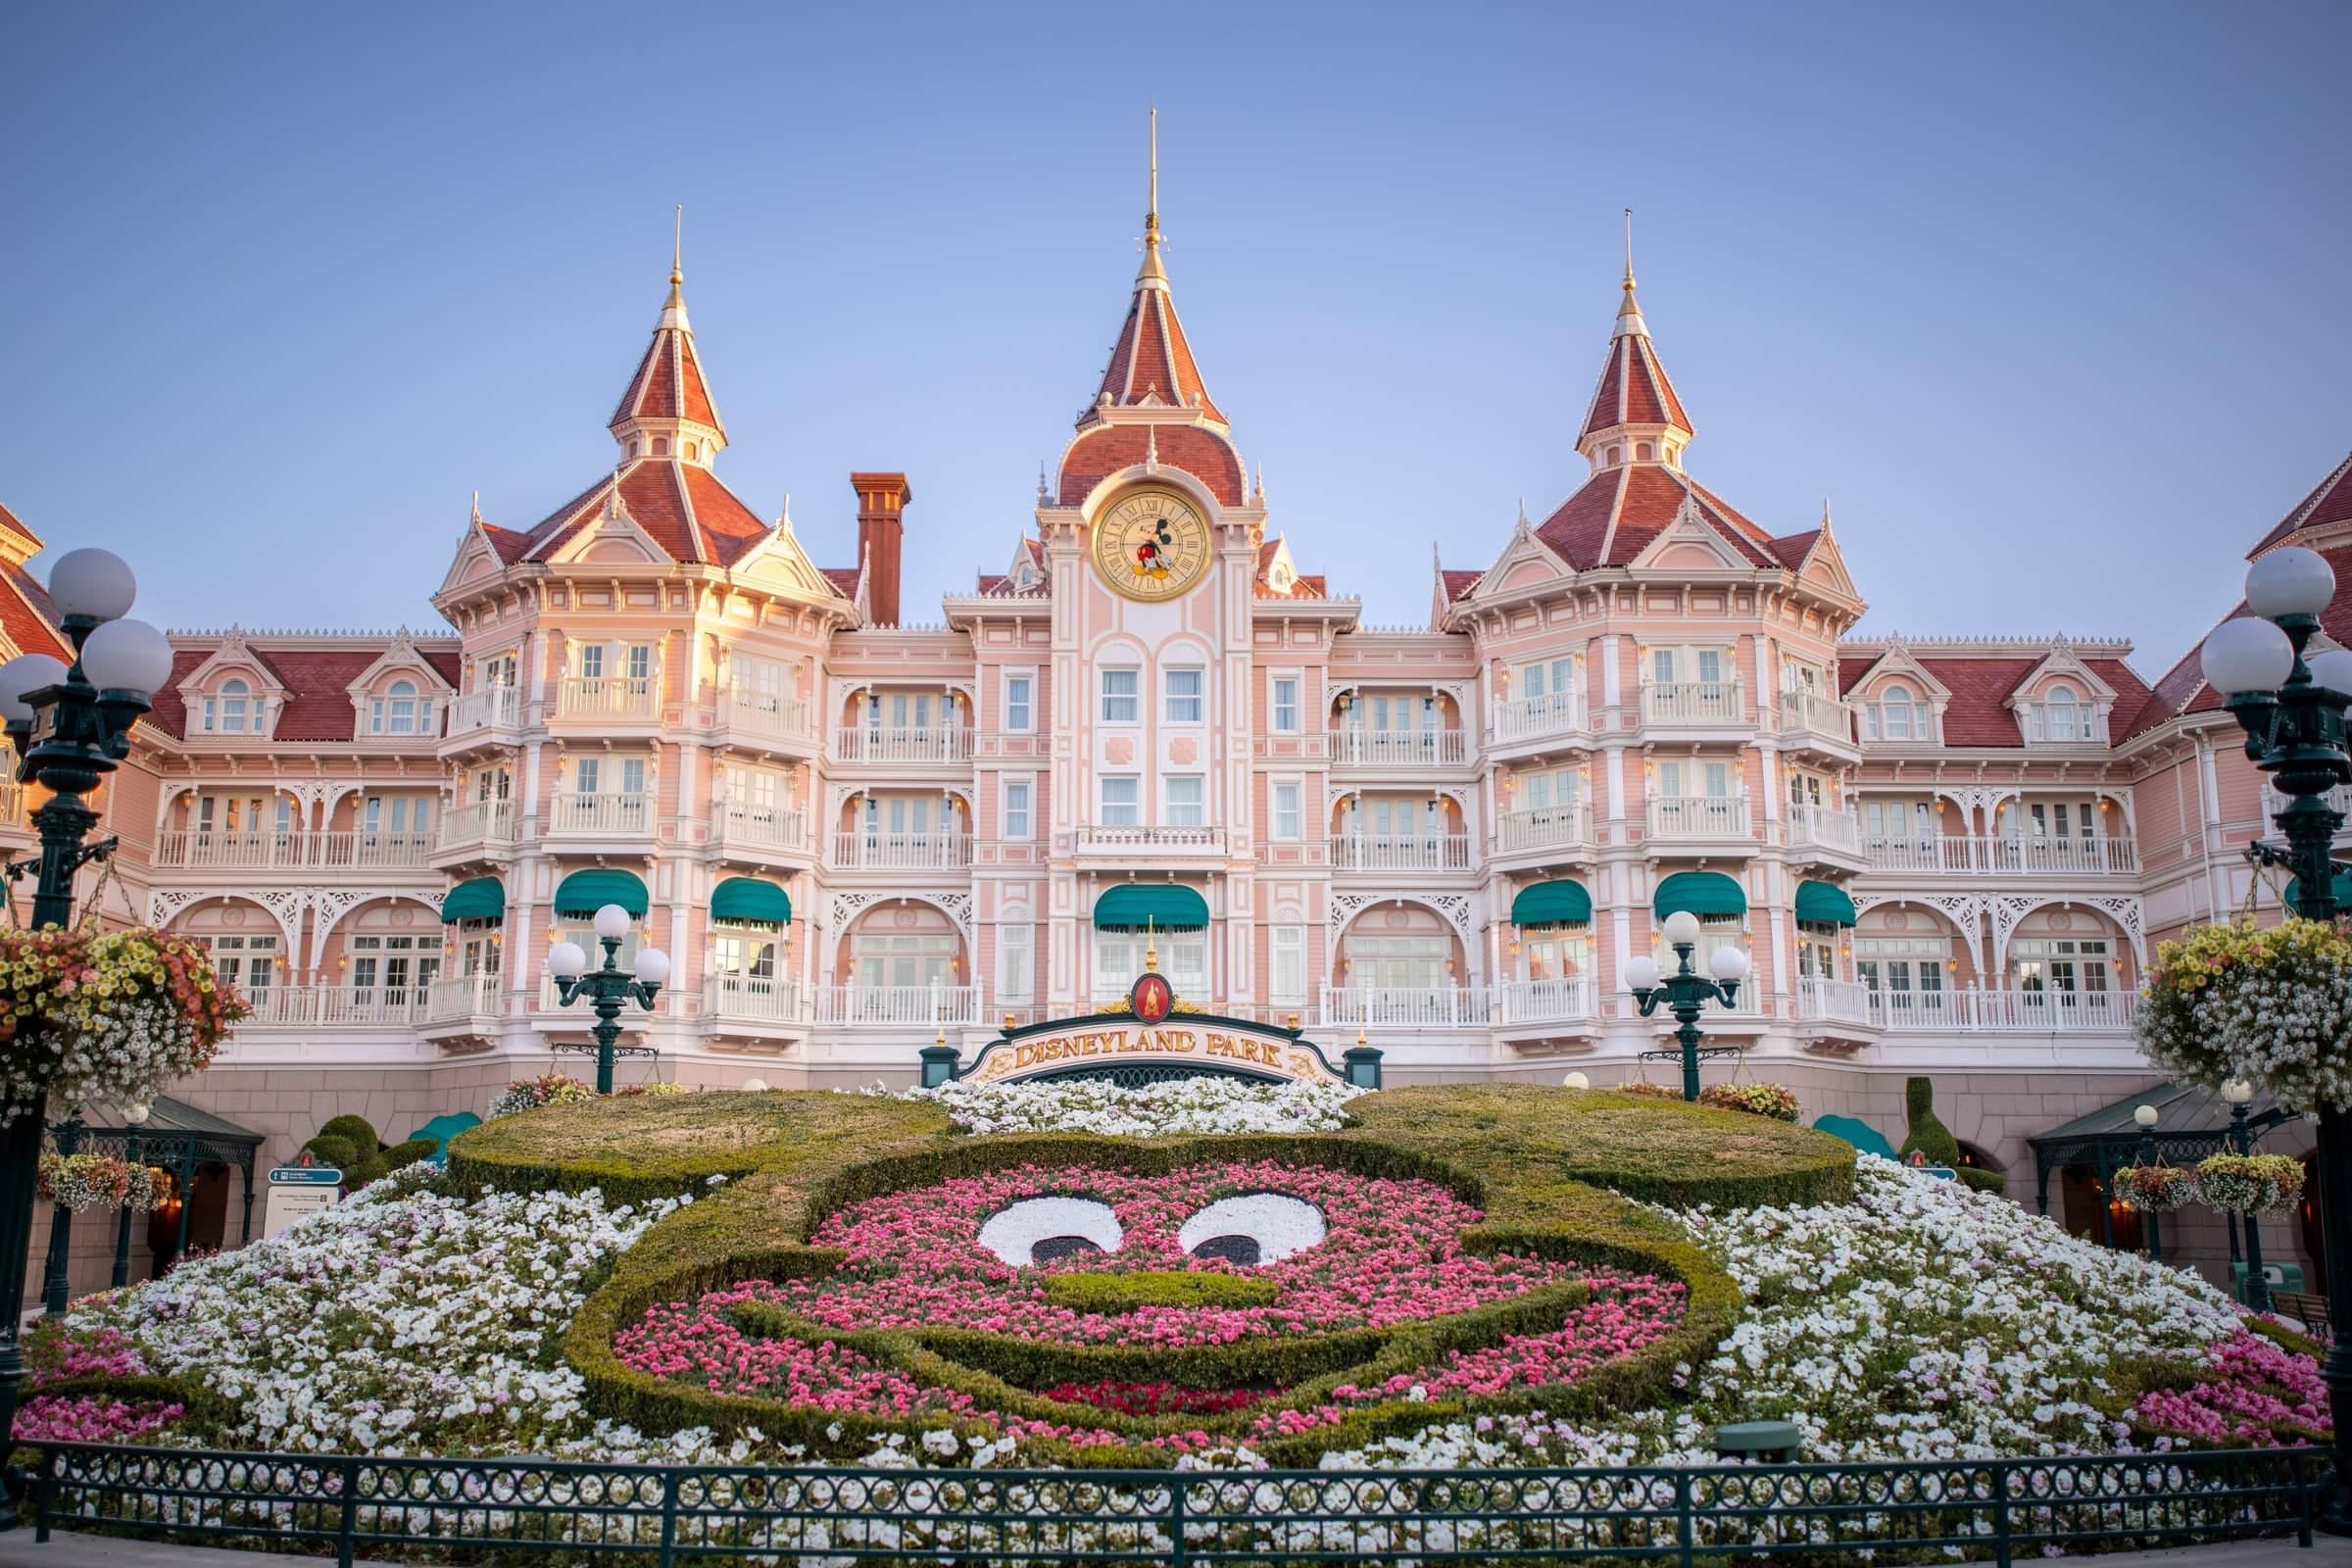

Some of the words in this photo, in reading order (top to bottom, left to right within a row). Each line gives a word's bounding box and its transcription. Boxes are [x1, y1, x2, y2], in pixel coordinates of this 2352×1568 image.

[1144, 500, 1157, 511] XII
[1186, 540, 1199, 549] III
[1015, 1030, 1197, 1069] DISNEYLAND
[1205, 1034, 1283, 1069] PARK
